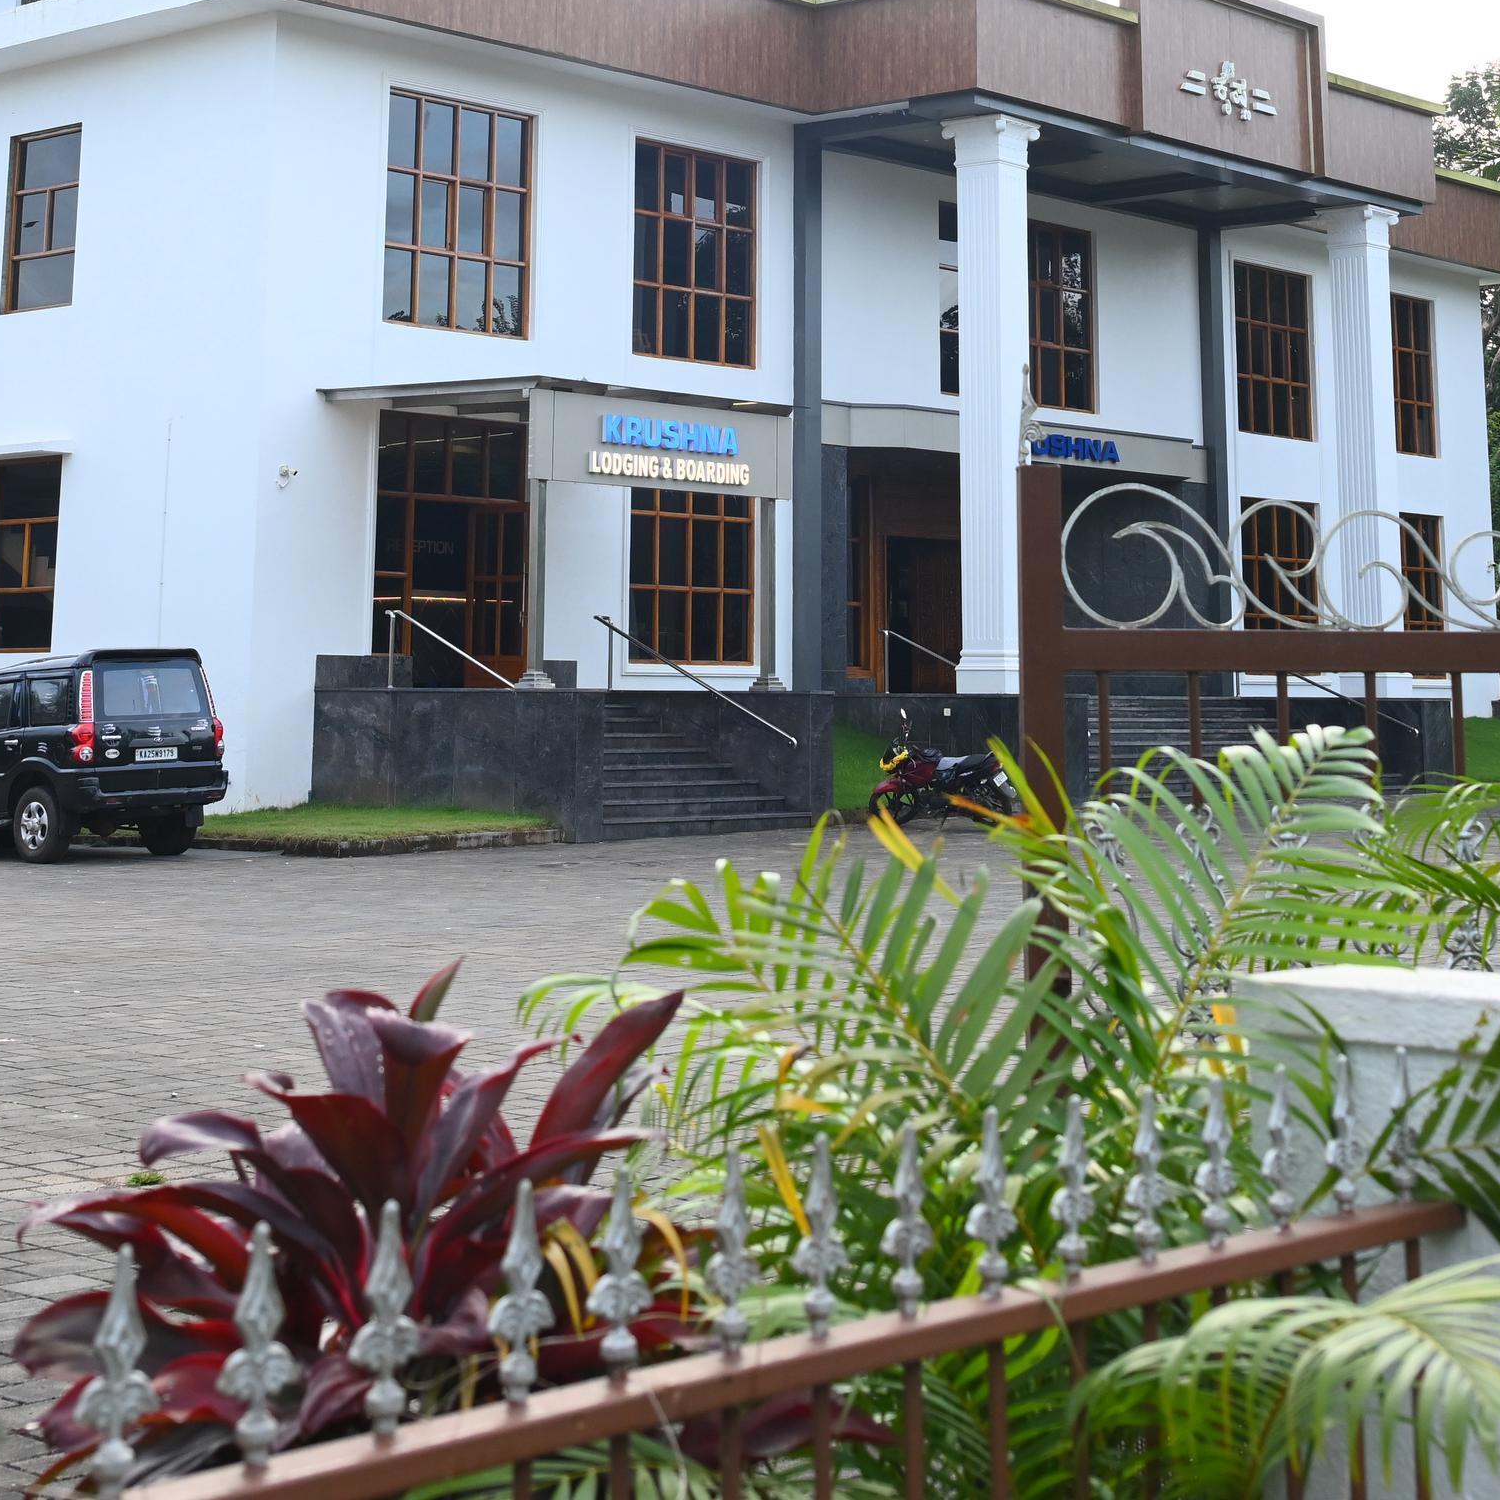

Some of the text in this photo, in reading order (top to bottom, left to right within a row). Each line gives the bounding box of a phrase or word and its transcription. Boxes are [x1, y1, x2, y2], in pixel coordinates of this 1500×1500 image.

[602, 414, 739, 455] KRUSHNA
[1031, 434, 1120, 464] USHNA
[590, 451, 750, 485] LODGING & BOARDING
[387, 537, 455, 557] REEPTION
